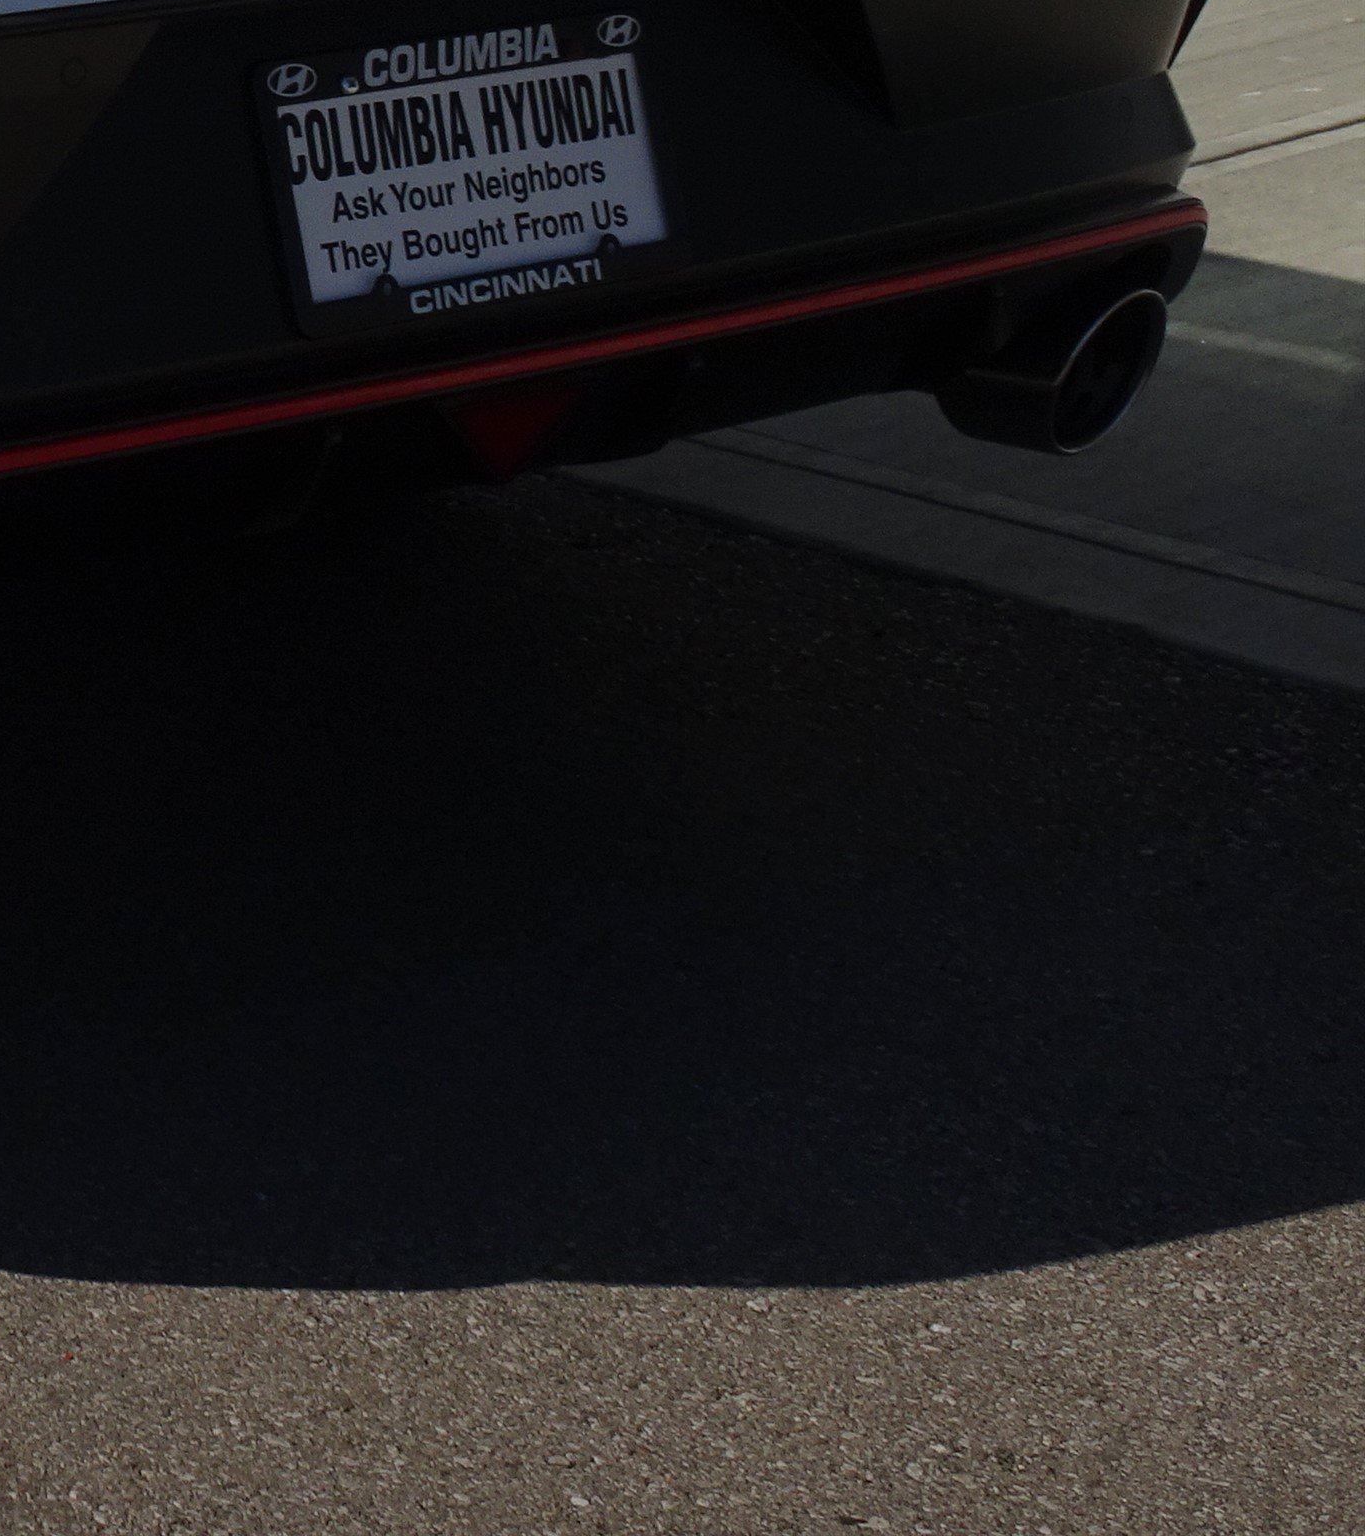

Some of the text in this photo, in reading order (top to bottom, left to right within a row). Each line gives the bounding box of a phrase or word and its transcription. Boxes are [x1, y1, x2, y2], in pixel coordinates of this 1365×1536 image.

[363, 24, 560, 88] COLUMBIA
[278, 68, 637, 186] COLUMBIA HYUNDAI
[331, 159, 607, 224] Ask Your Neighbors
[320, 198, 629, 275] They Bought From Us
[409, 258, 604, 315] CINCINNATI
